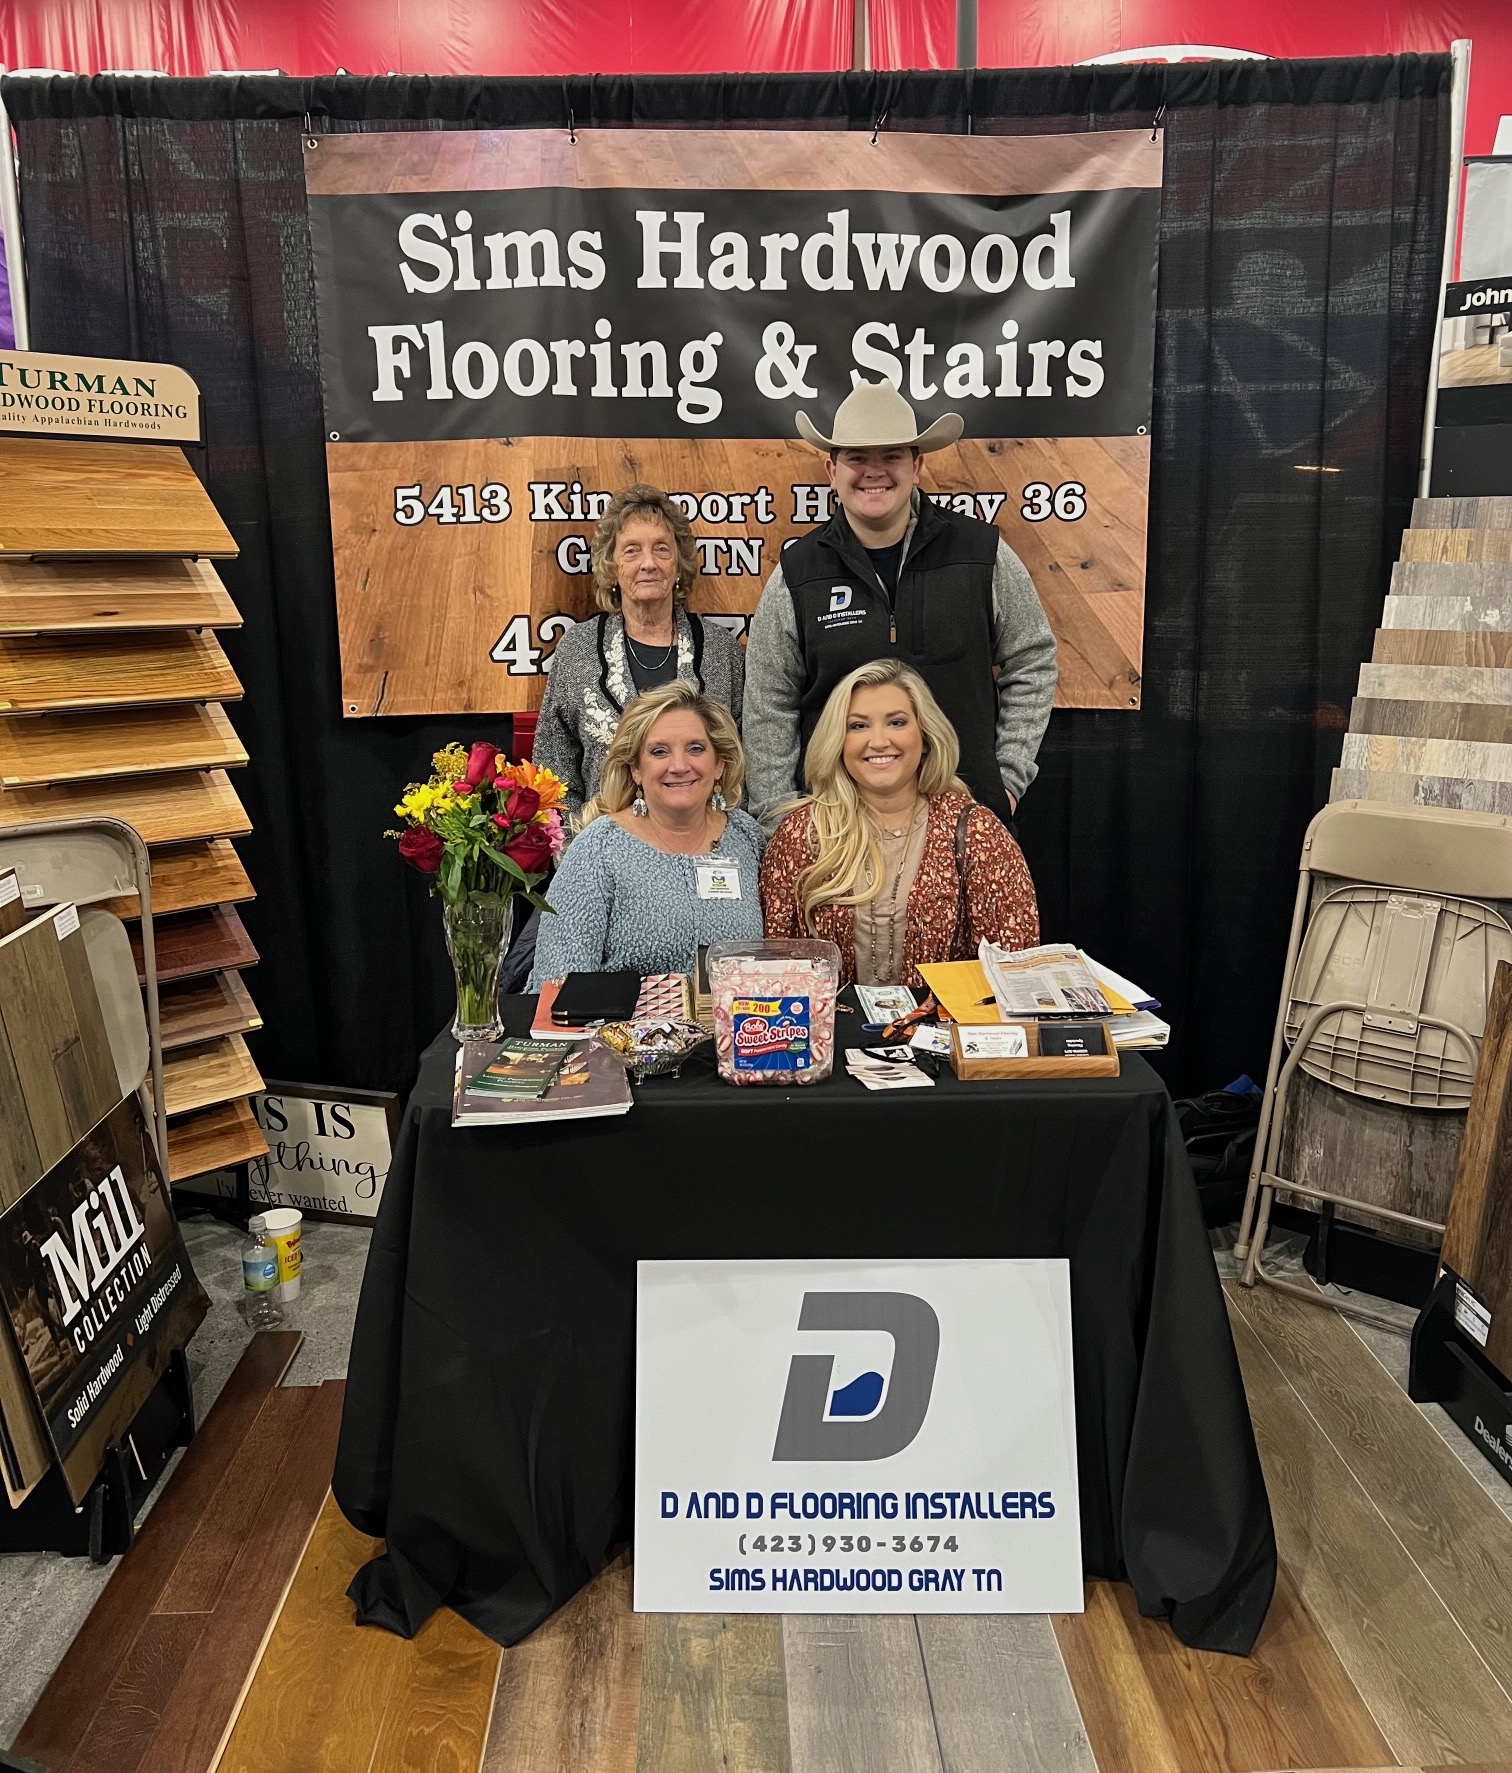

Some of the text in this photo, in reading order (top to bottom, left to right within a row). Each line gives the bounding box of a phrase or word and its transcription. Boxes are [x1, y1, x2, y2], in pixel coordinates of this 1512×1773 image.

[399, 208, 1076, 294] Sims Hardwood
[0, 362, 157, 398] TURMAN
[367, 318, 1105, 425] Flooring & Stairs
[32, 413, 99, 427] Appalachian
[104, 418, 161, 430] Hardwoods
[87, 399, 188, 419] FLOORING
[394, 483, 511, 525] 5413
[529, 482, 776, 524] Kinport
[1021, 481, 1087, 522] 36
[697, 537, 764, 576] TN
[837, 609, 867, 617] INSTALLERS
[752, 1002, 771, 1014] 200
[515, 1040, 568, 1048] TURMAN
[737, 1025, 806, 1045] Sweet Stripes
[310, 1101, 356, 1140] IS
[286, 1195, 353, 1213] wanted.
[40, 1164, 145, 1327] Mill
[74, 1243, 152, 1354] COLLECTION
[67, 1263, 182, 1429] Solid Hardwood Light Distressed
[661, 1491, 1055, 1520] D AND D FLOORING INSTALLERS
[738, 1534, 959, 1556] (423)930-3674
[709, 1568, 1003, 1592] SIMS HARDWOOD GRAY TN
